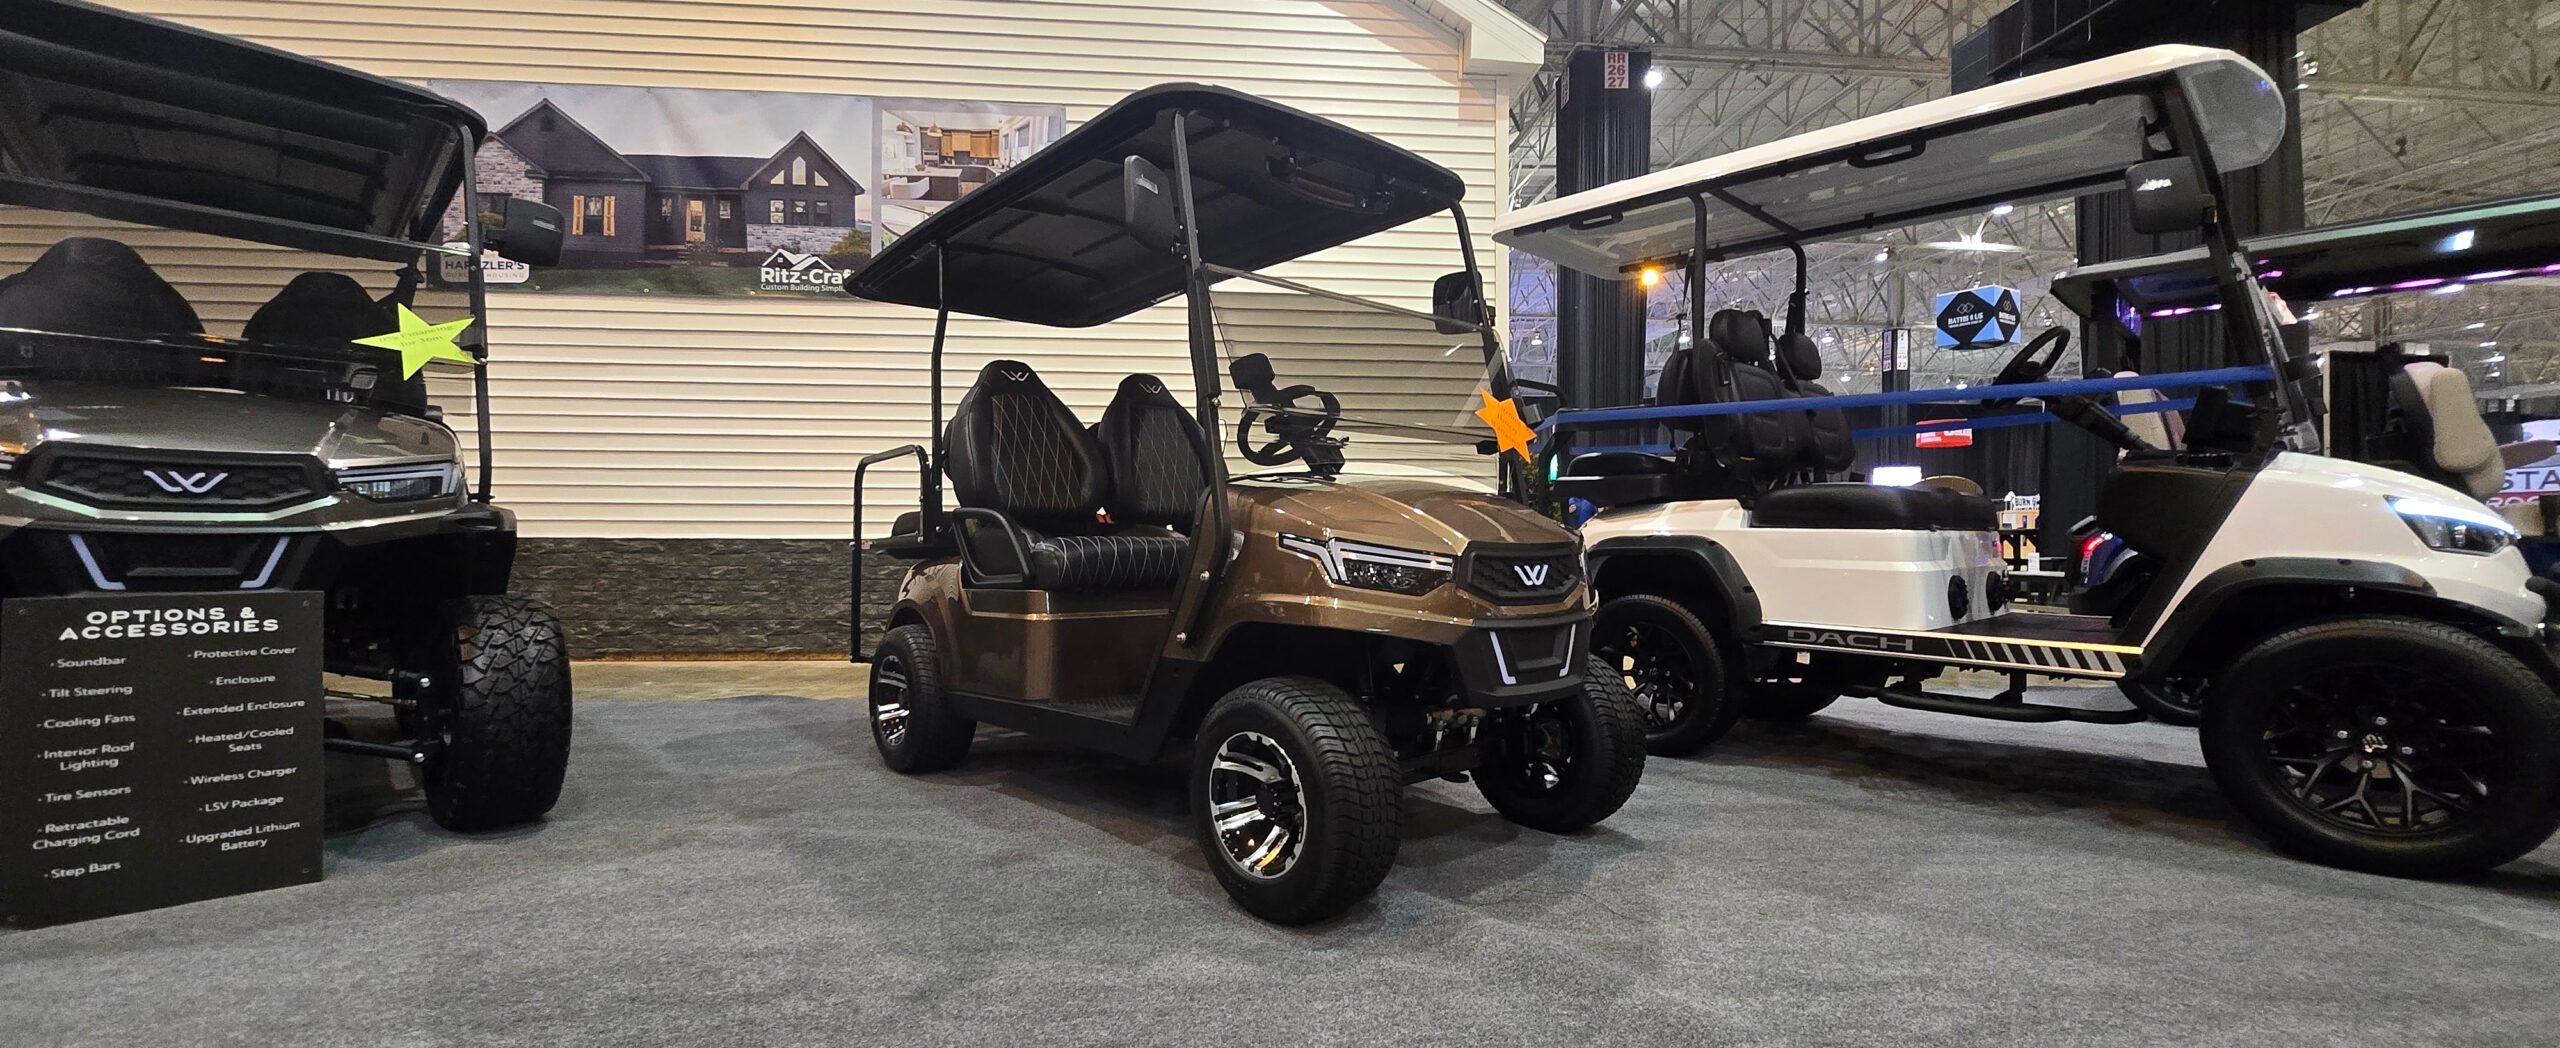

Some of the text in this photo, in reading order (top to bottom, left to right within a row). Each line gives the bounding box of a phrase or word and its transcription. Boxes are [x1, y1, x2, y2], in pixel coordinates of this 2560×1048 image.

[1608, 54, 1625, 63] RR
[1608, 65, 1625, 75] 26
[1608, 77, 1624, 87] 27
[760, 266, 856, 285] Ritz-Craf
[760, 283, 789, 291] Custom
[790, 284, 820, 293] Building
[87, 607, 256, 623] OPTIONS &
[59, 618, 278, 640] ACCESSORIES
[1787, 629, 1914, 652] DACH
[260, 646, 297, 656] Cover
[73, 686, 133, 697] Steering
[247, 700, 306, 711] Enclosure
[104, 714, 136, 724] Fans
[101, 742, 135, 753] Roof
[228, 743, 263, 753] Seats
[59, 759, 119, 771] Lighting
[247, 768, 297, 778] Charger
[75, 787, 132, 799] Sensors
[231, 797, 284, 808] Package
[255, 822, 301, 833] Lithium
[33, 828, 141, 849] Charging Cord
[221, 839, 268, 851] Battery
[88, 862, 121, 873] Bars
